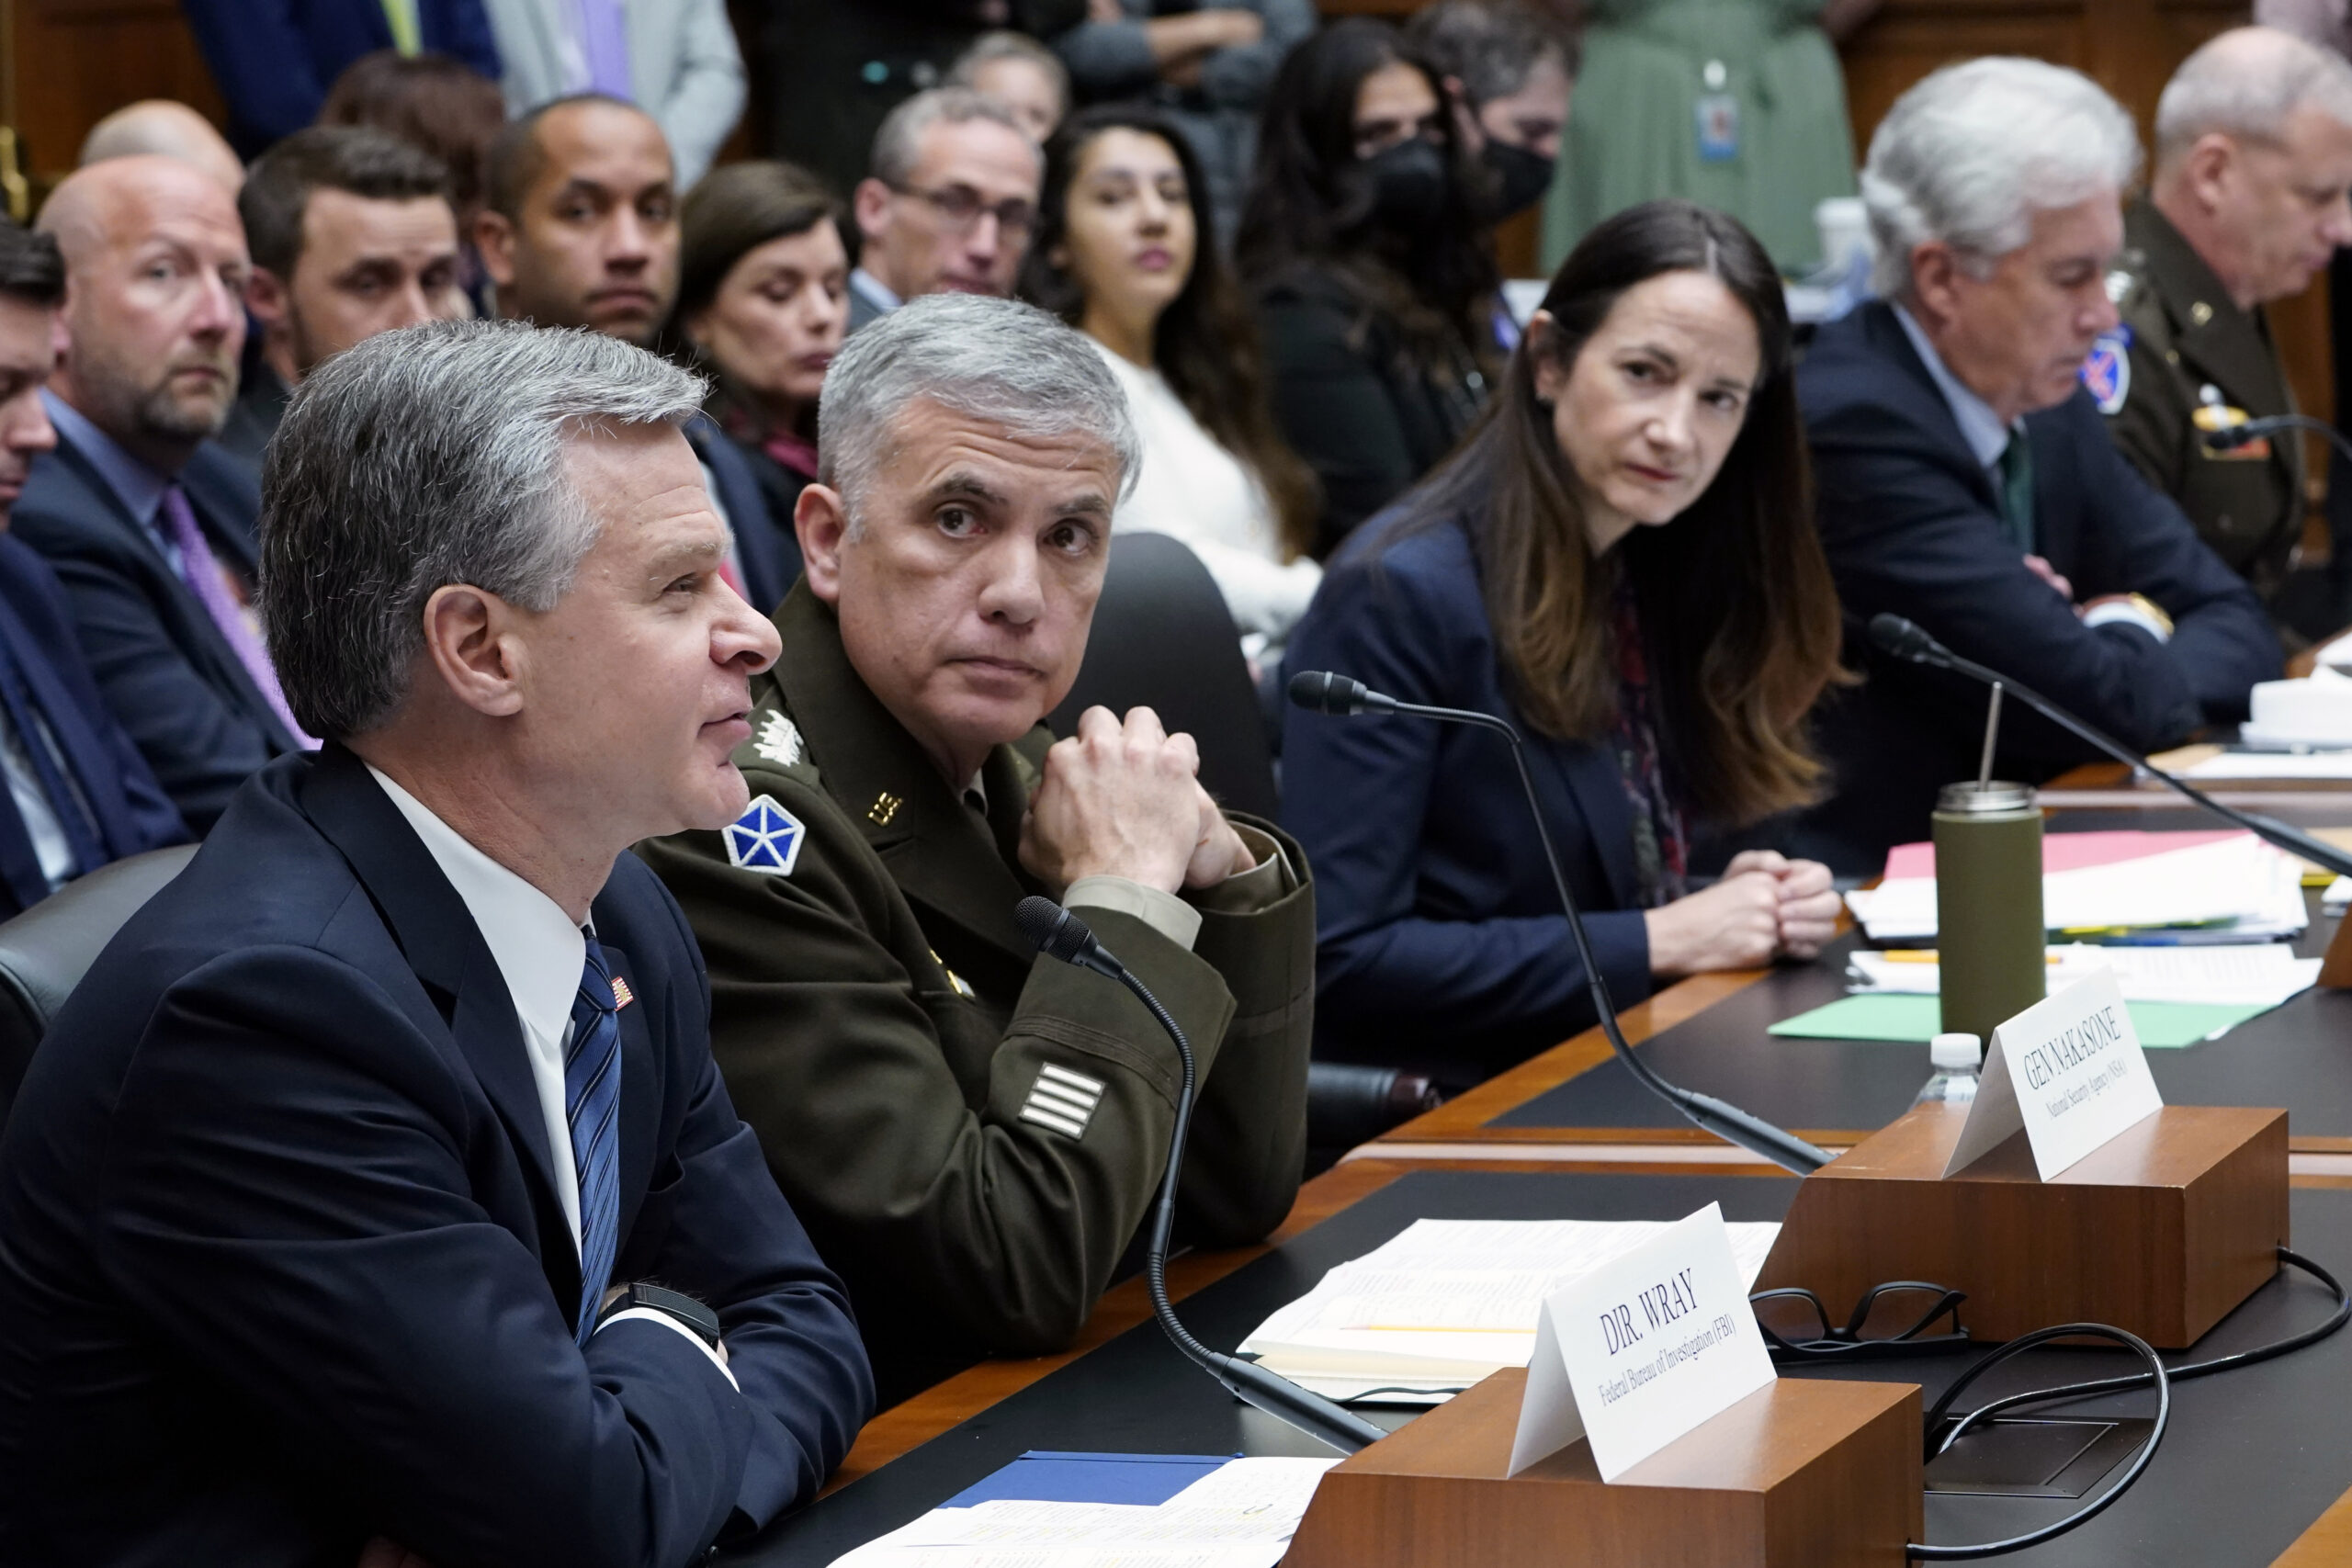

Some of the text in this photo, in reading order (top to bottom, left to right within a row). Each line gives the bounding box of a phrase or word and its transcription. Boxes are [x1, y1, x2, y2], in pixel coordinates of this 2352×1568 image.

[2049, 1006, 2121, 1075] NAKASONE
[1599, 1268, 1698, 1356] DIR. WRAY
[1598, 1313, 1736, 1406] Federal Bureau of Investigation (FBI)
